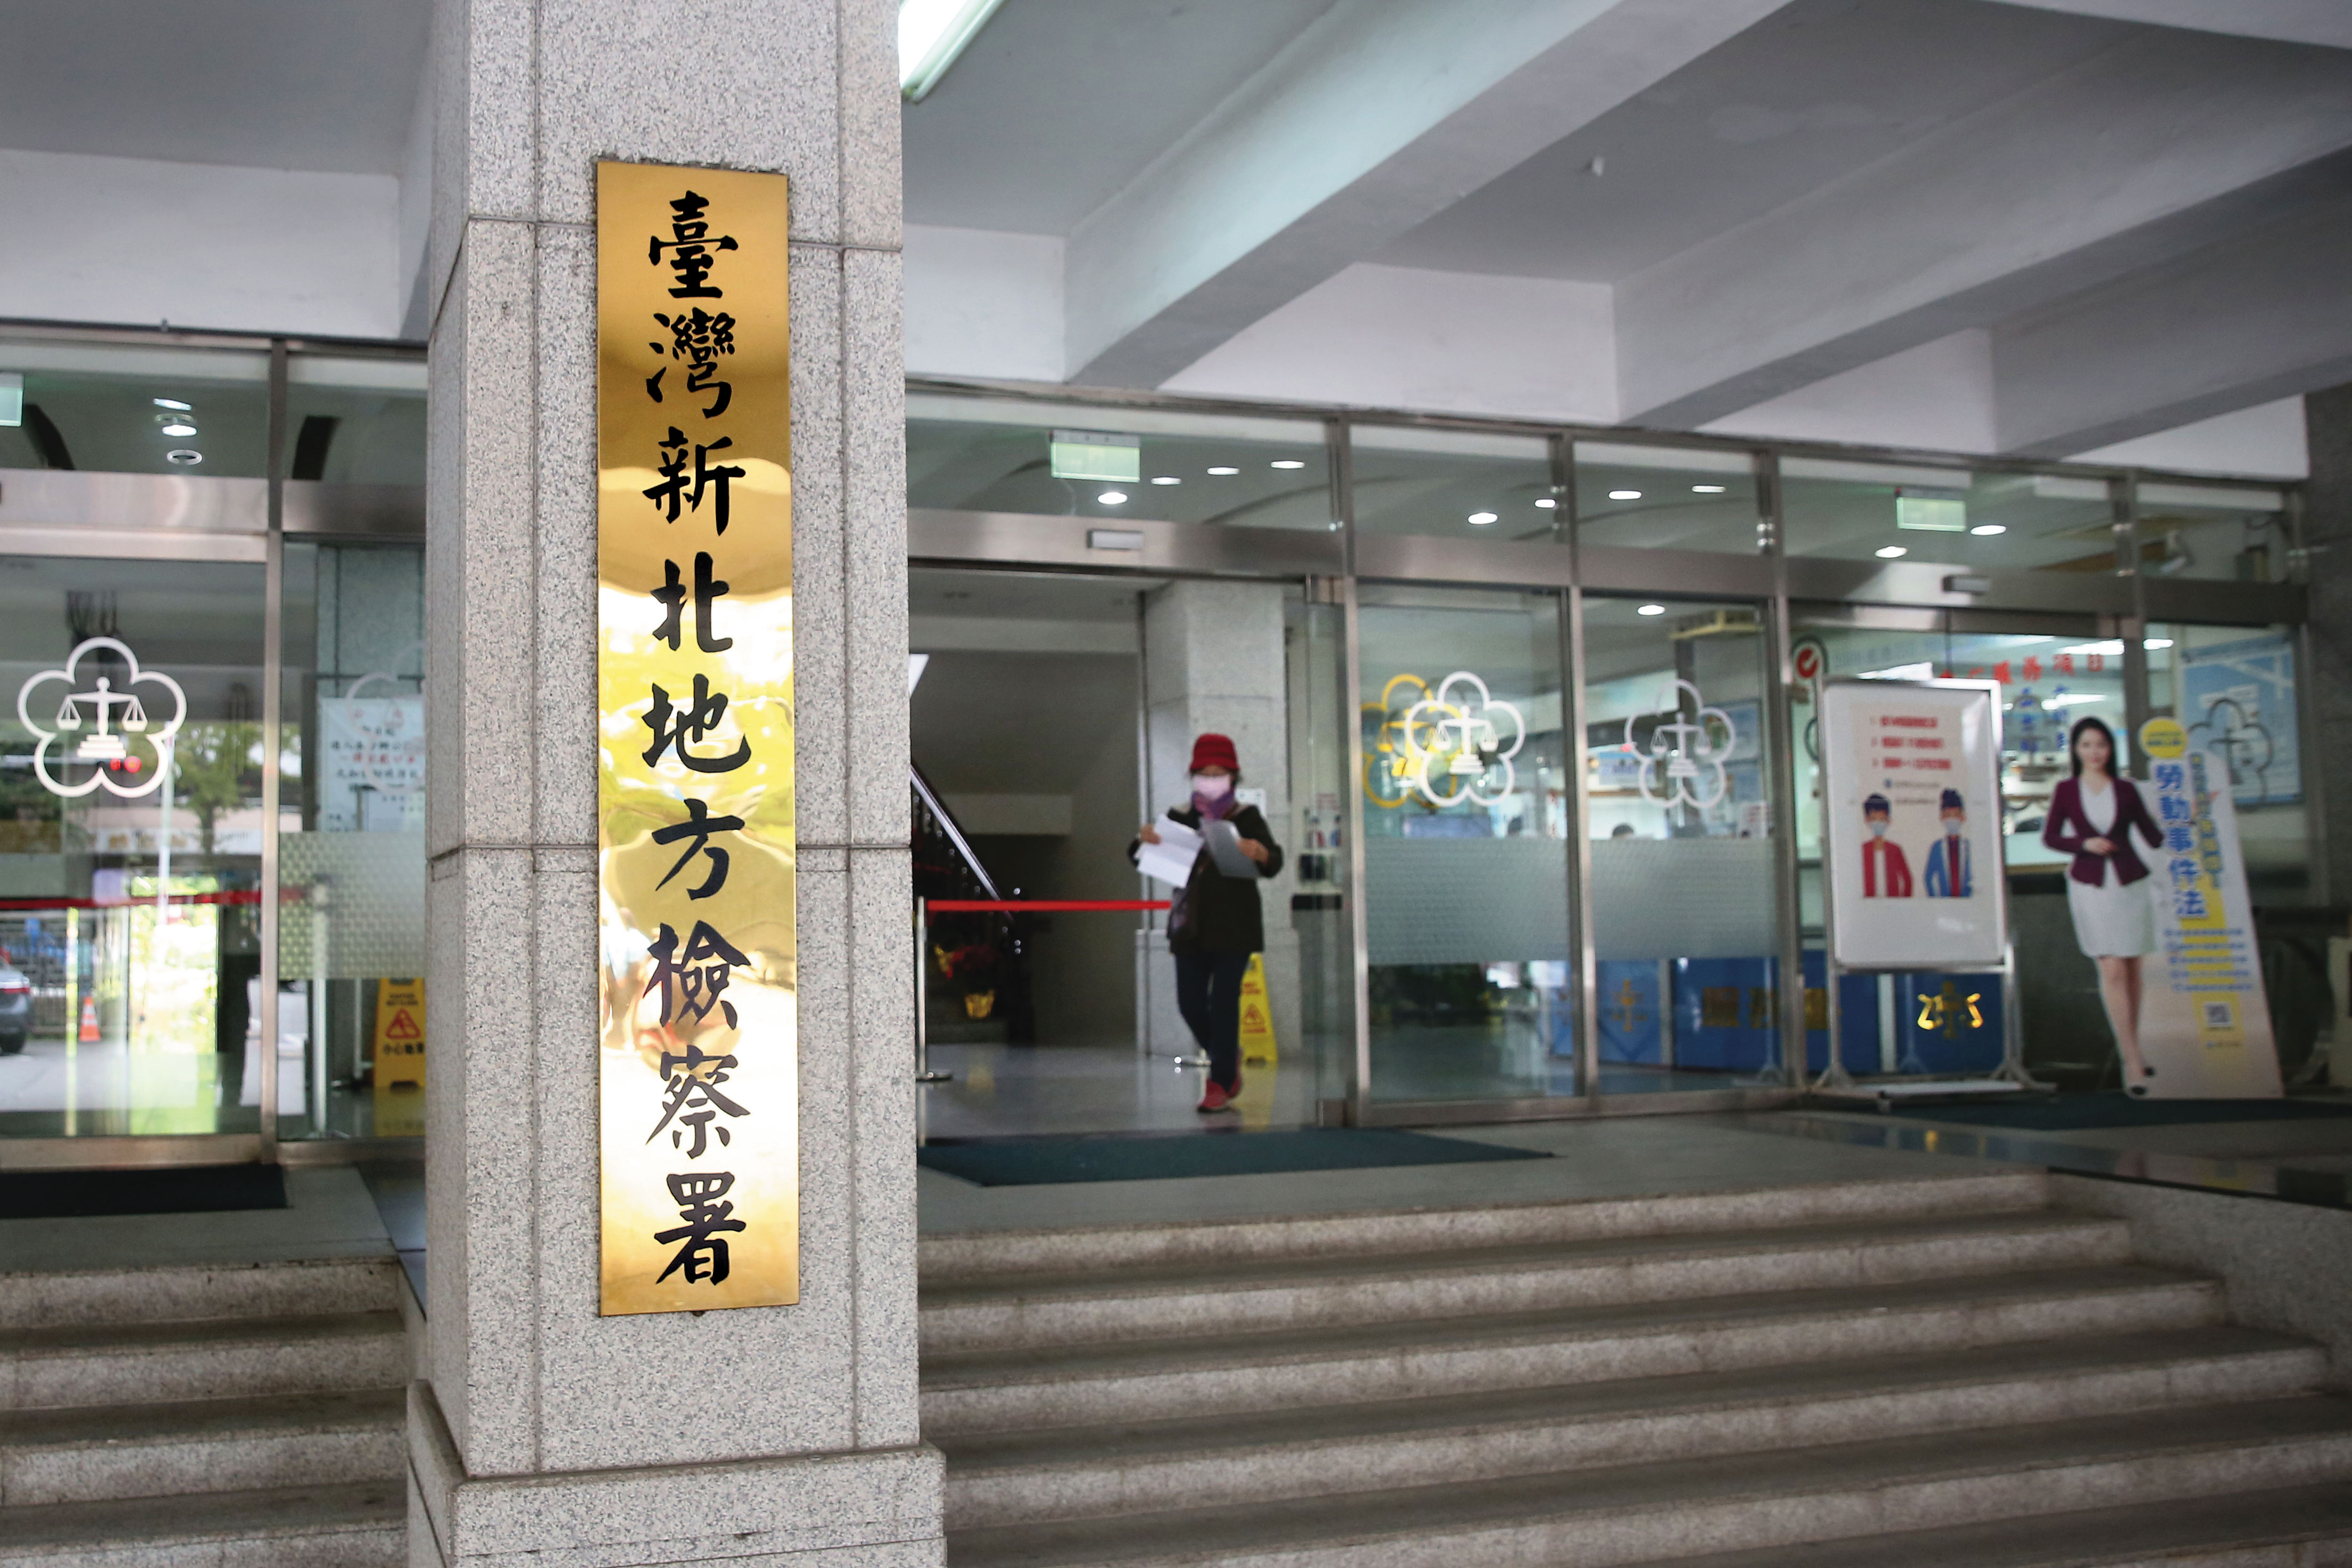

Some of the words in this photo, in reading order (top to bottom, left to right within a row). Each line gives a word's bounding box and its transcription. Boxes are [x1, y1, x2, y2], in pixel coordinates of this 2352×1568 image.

[642, 190, 752, 1286] 臺灣新北地方檢察署
